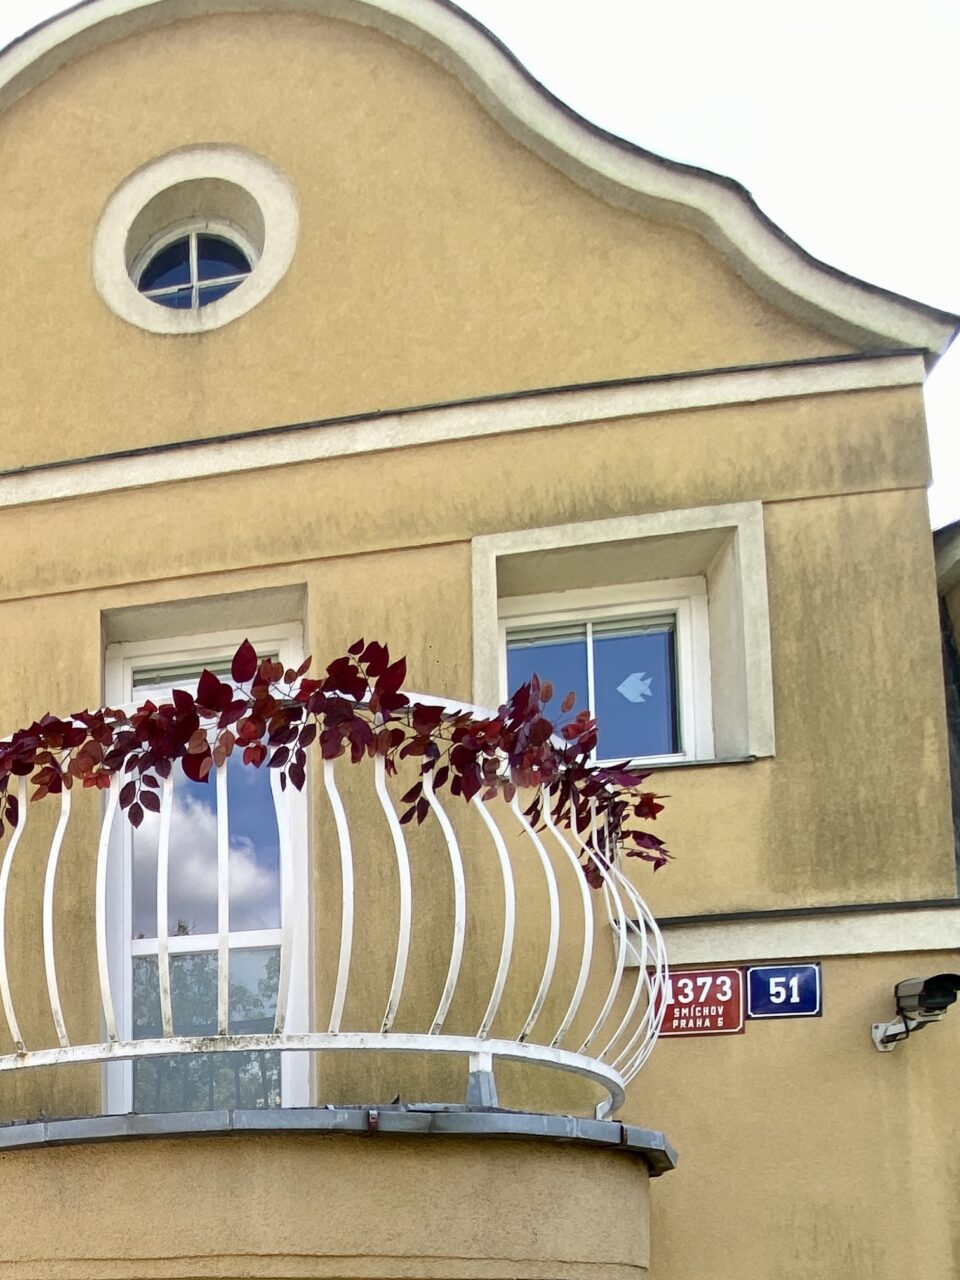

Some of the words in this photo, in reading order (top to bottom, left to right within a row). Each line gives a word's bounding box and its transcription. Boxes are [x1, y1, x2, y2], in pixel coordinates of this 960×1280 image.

[665, 975, 732, 1005] 1373
[769, 976, 800, 1004] 51
[673, 1005, 725, 1018] SMÍCHOV
[672, 1018, 711, 1030] PRAHA
